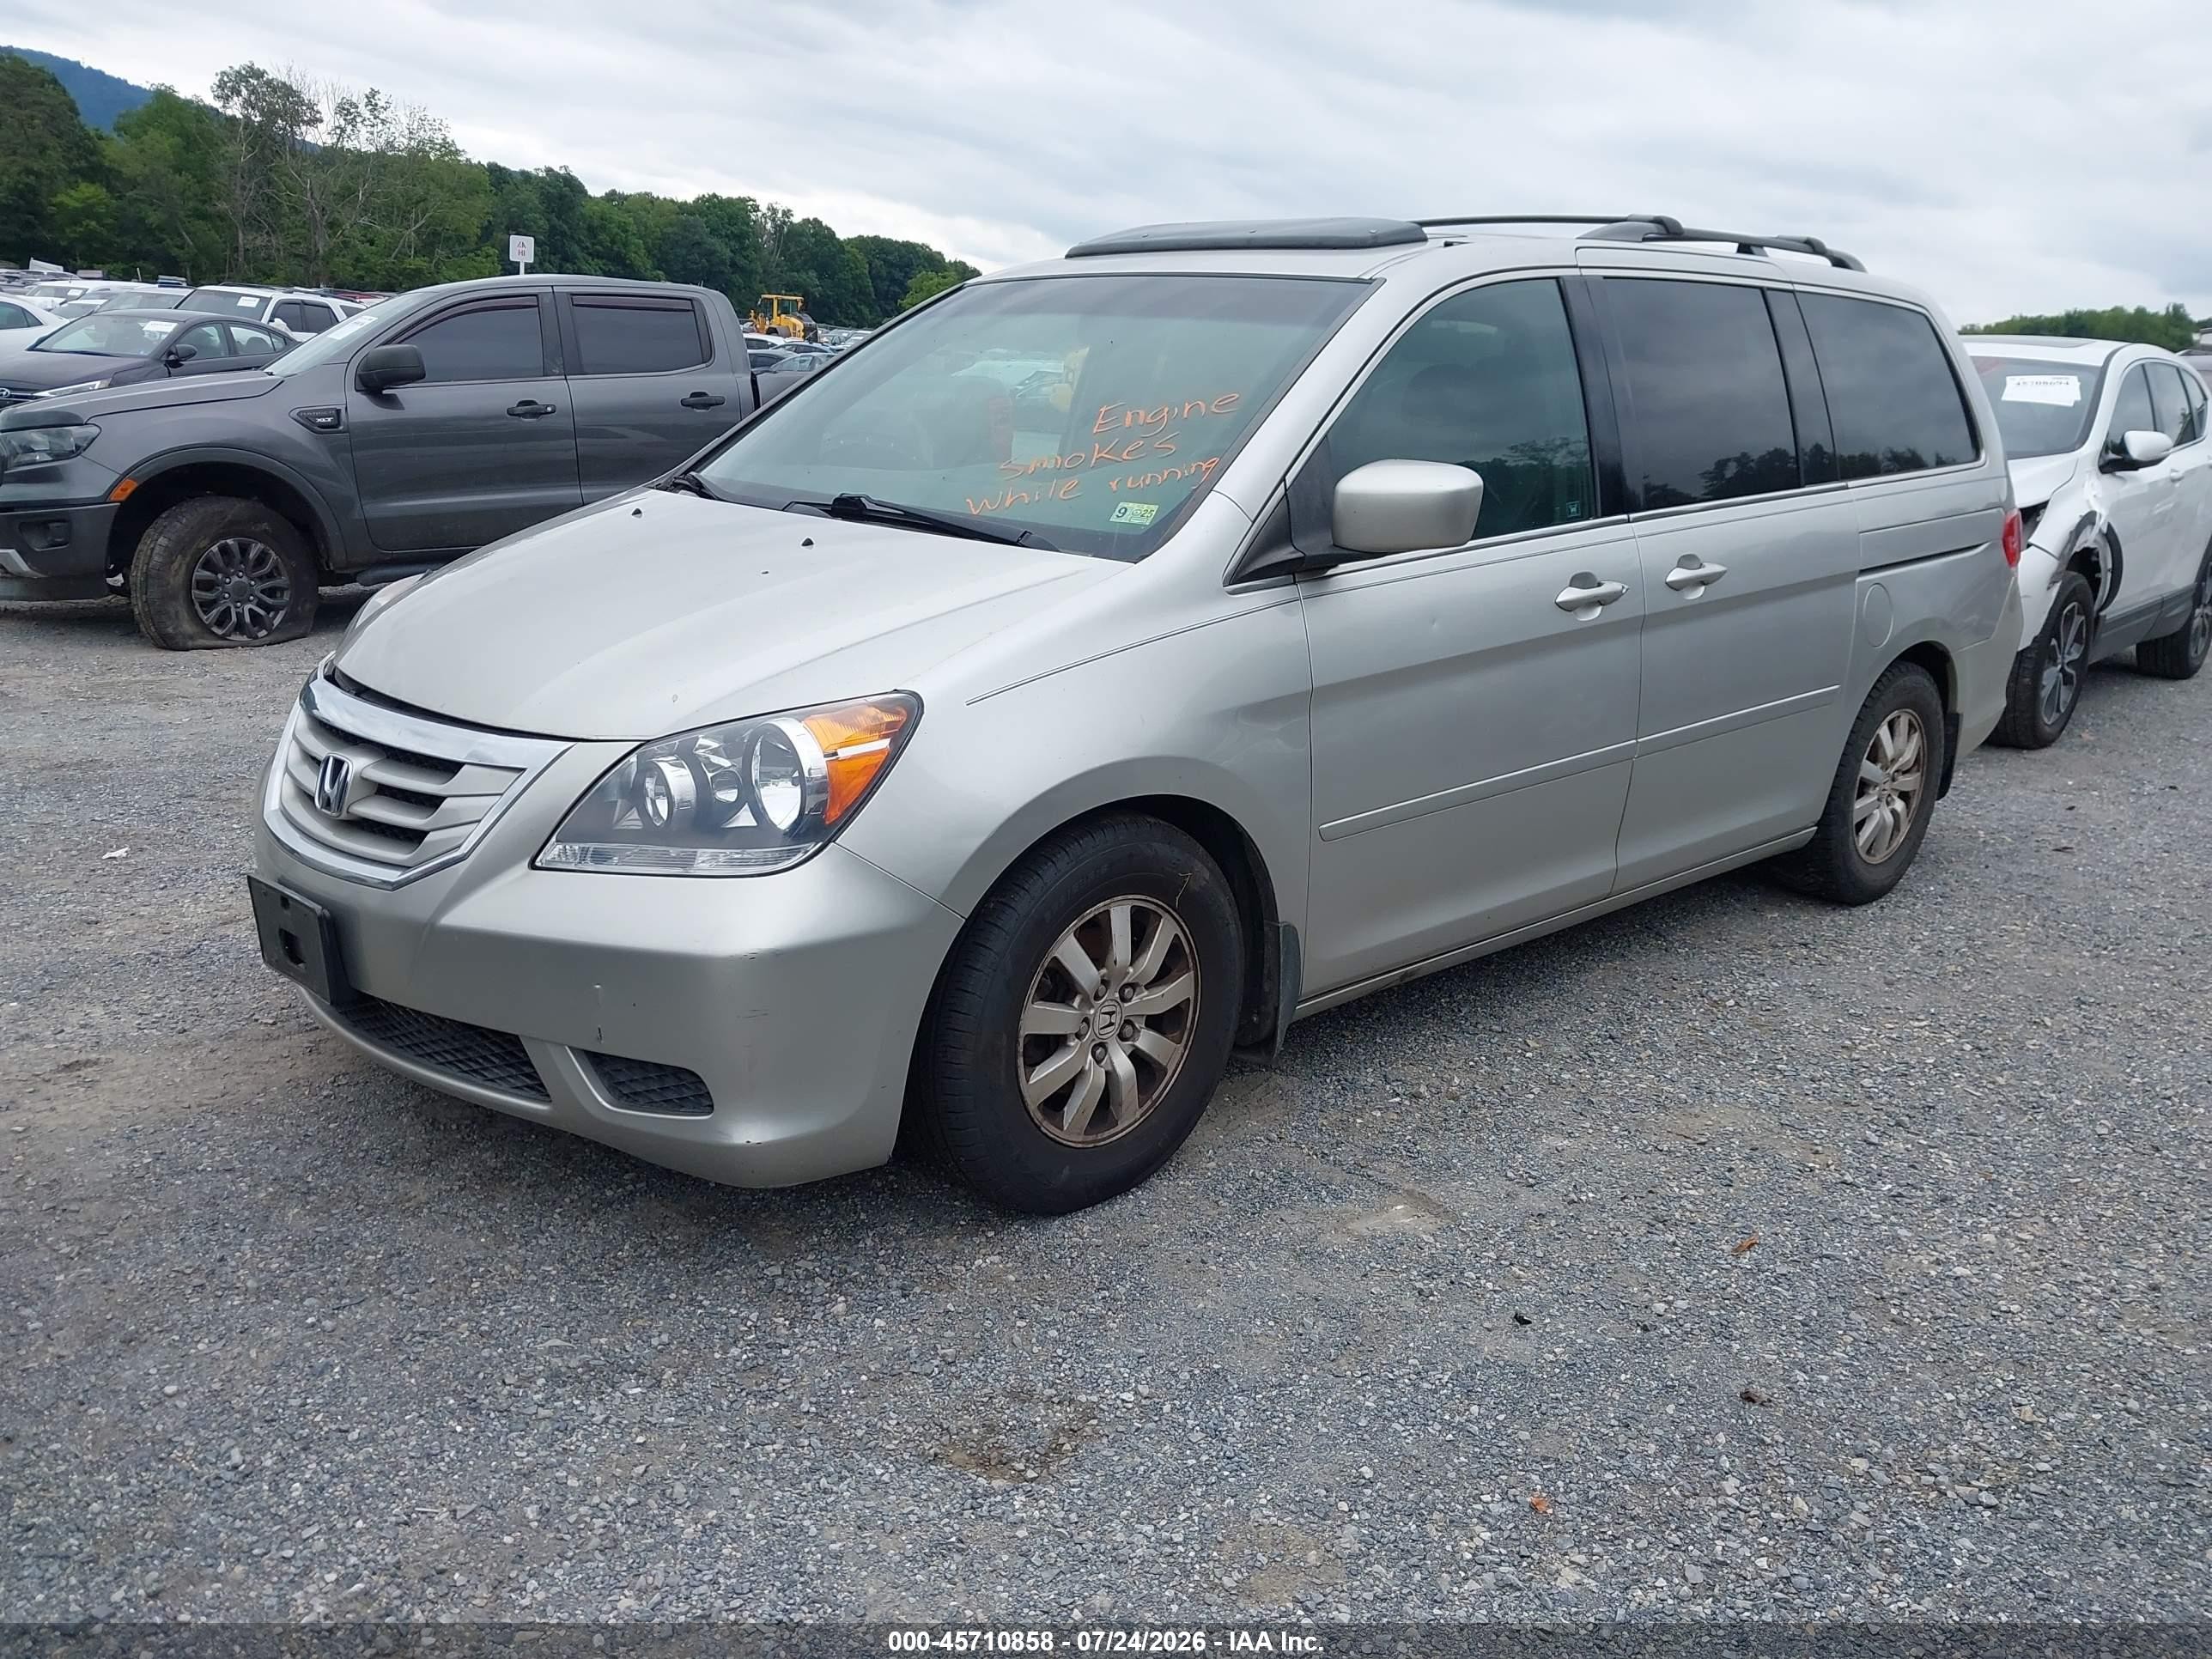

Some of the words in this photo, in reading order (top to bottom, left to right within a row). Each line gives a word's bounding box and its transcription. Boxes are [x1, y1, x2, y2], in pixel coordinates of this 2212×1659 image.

[1093, 392, 1240, 438] Engine
[1109, 456, 1220, 489] running
[1115, 507, 1128, 519] 9
[1139, 509, 1155, 519] 25
